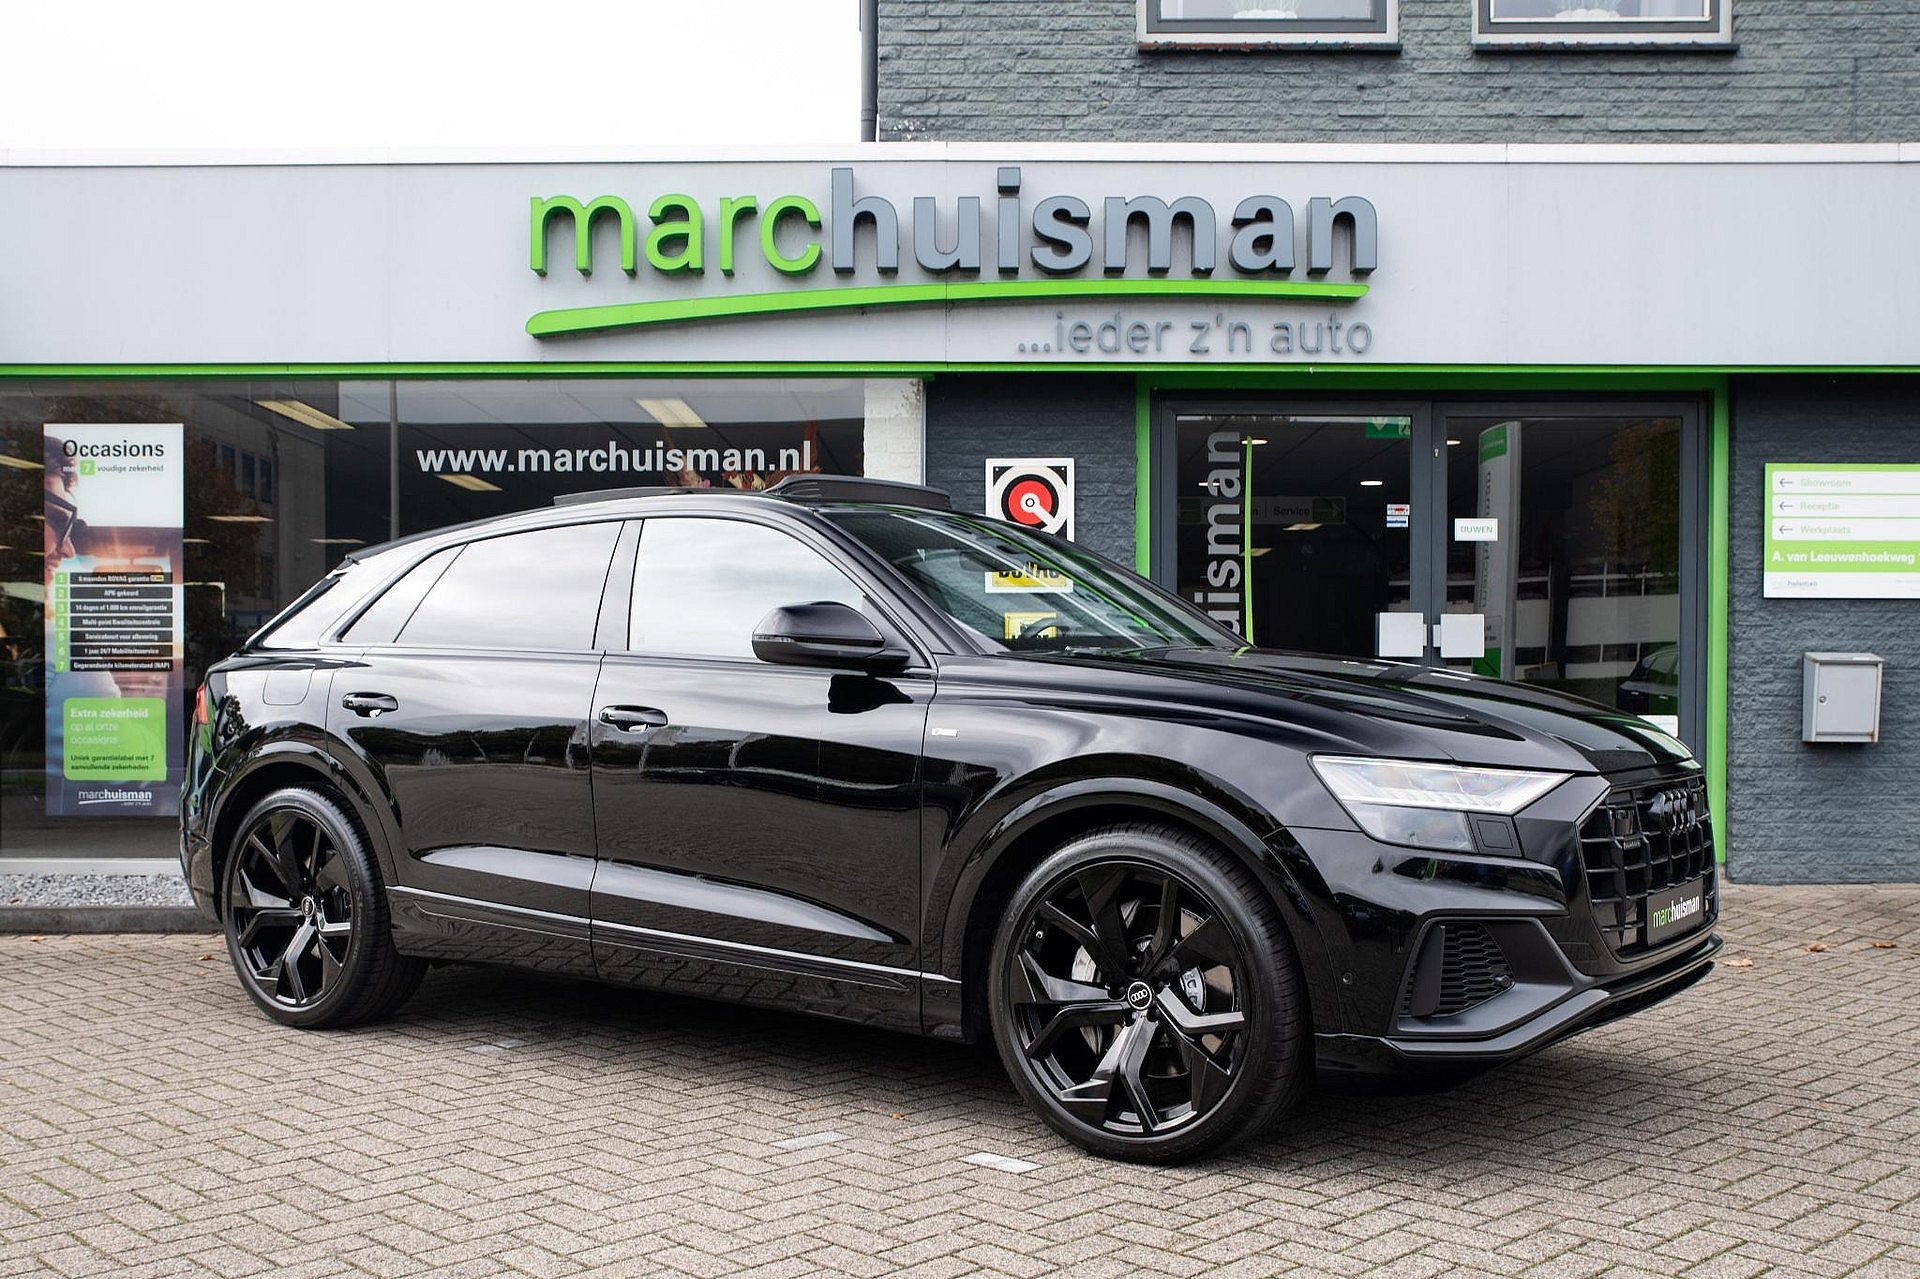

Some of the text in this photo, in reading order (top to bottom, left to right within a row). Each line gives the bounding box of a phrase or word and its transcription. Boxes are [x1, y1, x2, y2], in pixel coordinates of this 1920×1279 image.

[529, 167, 1378, 277] marchuisman
[1190, 312, 1251, 353] z'n
[1270, 312, 1373, 353] auto
[63, 440, 164, 457] Occasions
[416, 440, 811, 473] www.marchuisman.nl
[97, 465, 126, 474] voudige
[1800, 478, 1851, 488] Showroom
[1273, 505, 1310, 516] Service
[1800, 502, 1840, 512] Receptie
[1460, 525, 1493, 533] DUWEN
[1800, 525, 1851, 535] Werkplaats
[1772, 551, 1916, 564] A. van Leeuwenhoekweg
[70, 708, 149, 718] Extra zekerheid
[71, 735, 118, 744] occasions
[78, 788, 152, 799] marchuisman
[1653, 896, 1700, 929] marchuisman
